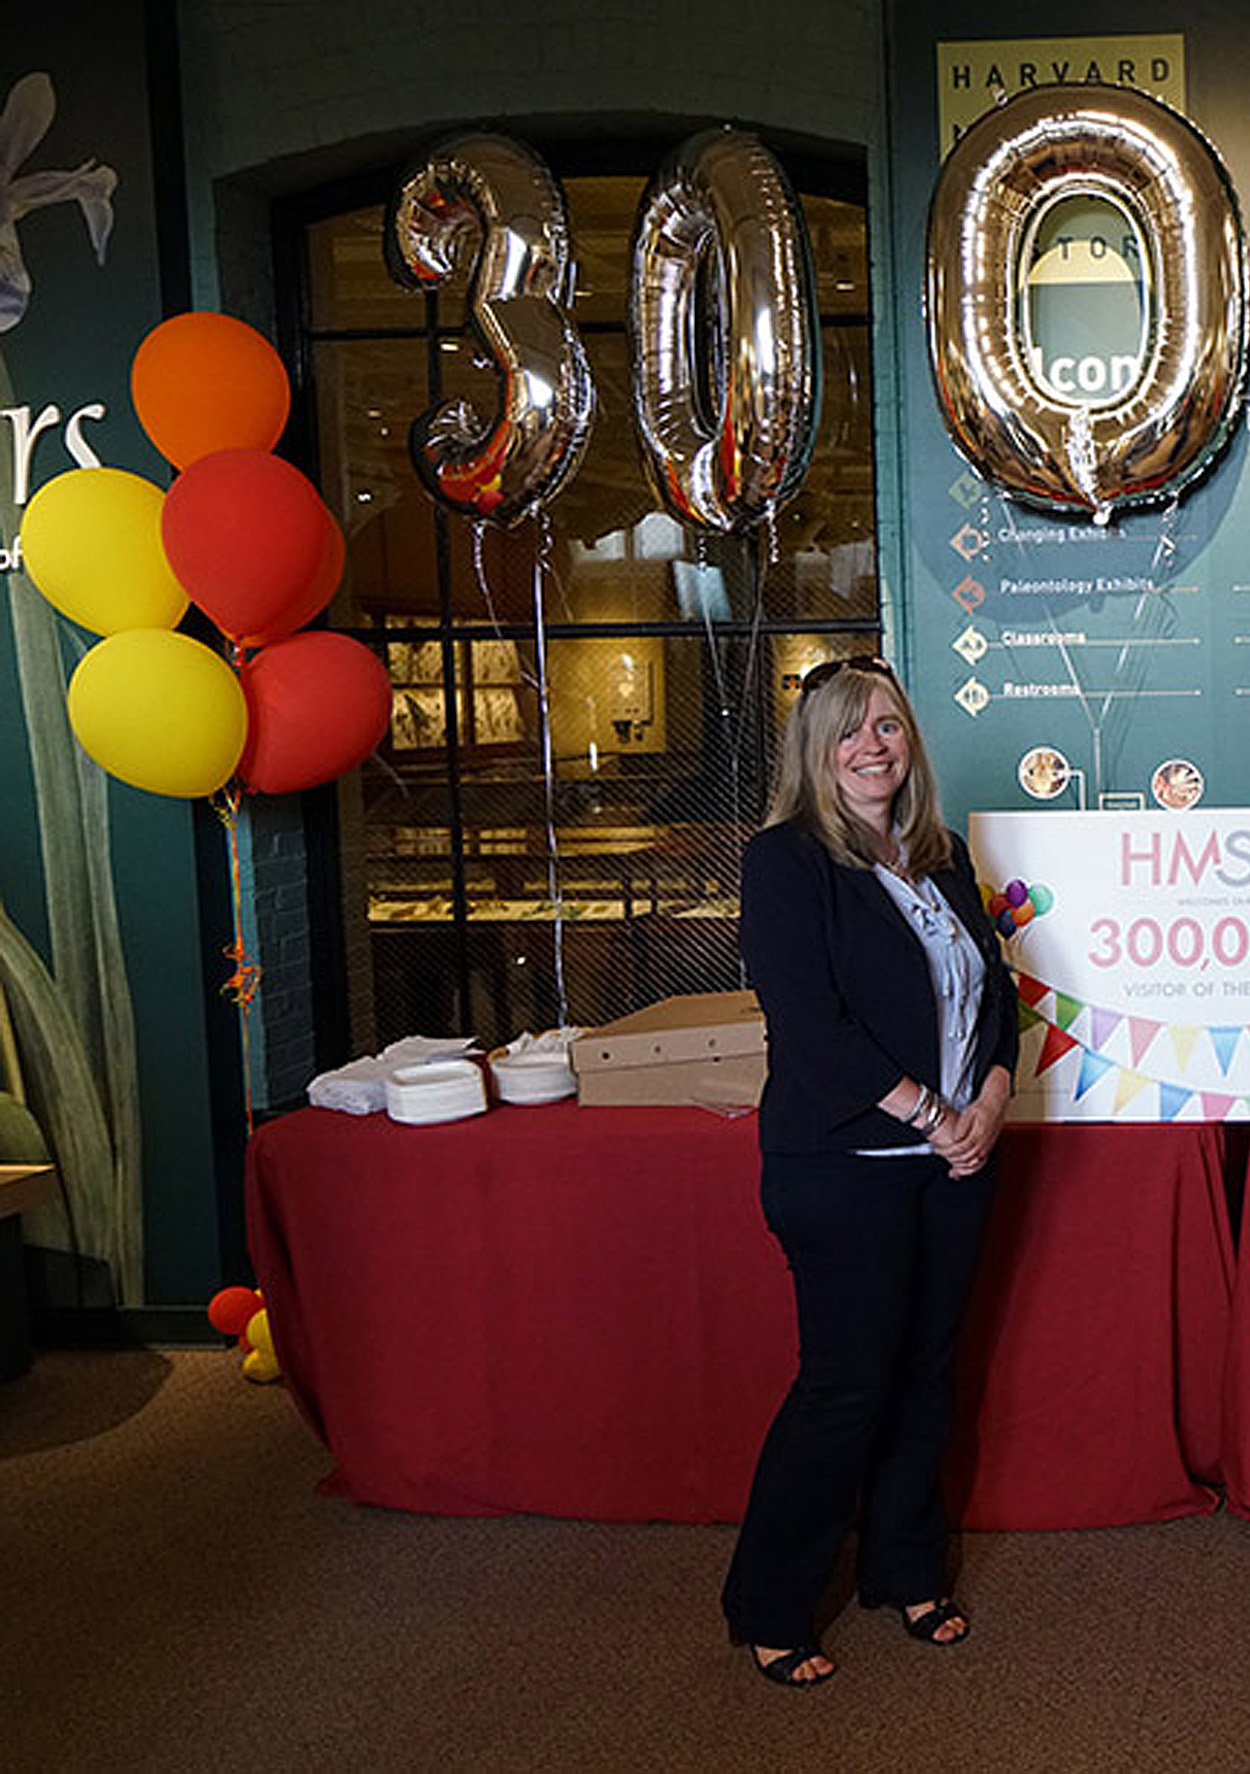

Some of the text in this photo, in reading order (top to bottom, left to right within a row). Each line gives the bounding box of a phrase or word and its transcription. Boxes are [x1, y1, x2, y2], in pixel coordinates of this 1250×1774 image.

[952, 58, 1170, 89] HARVARD
[0, 403, 106, 504] rs
[1001, 630, 1086, 646] Classrooms
[1003, 681, 1081, 697] Restrooms
[1123, 980, 1187, 998] VISITOR
[1192, 980, 1214, 997] OF
